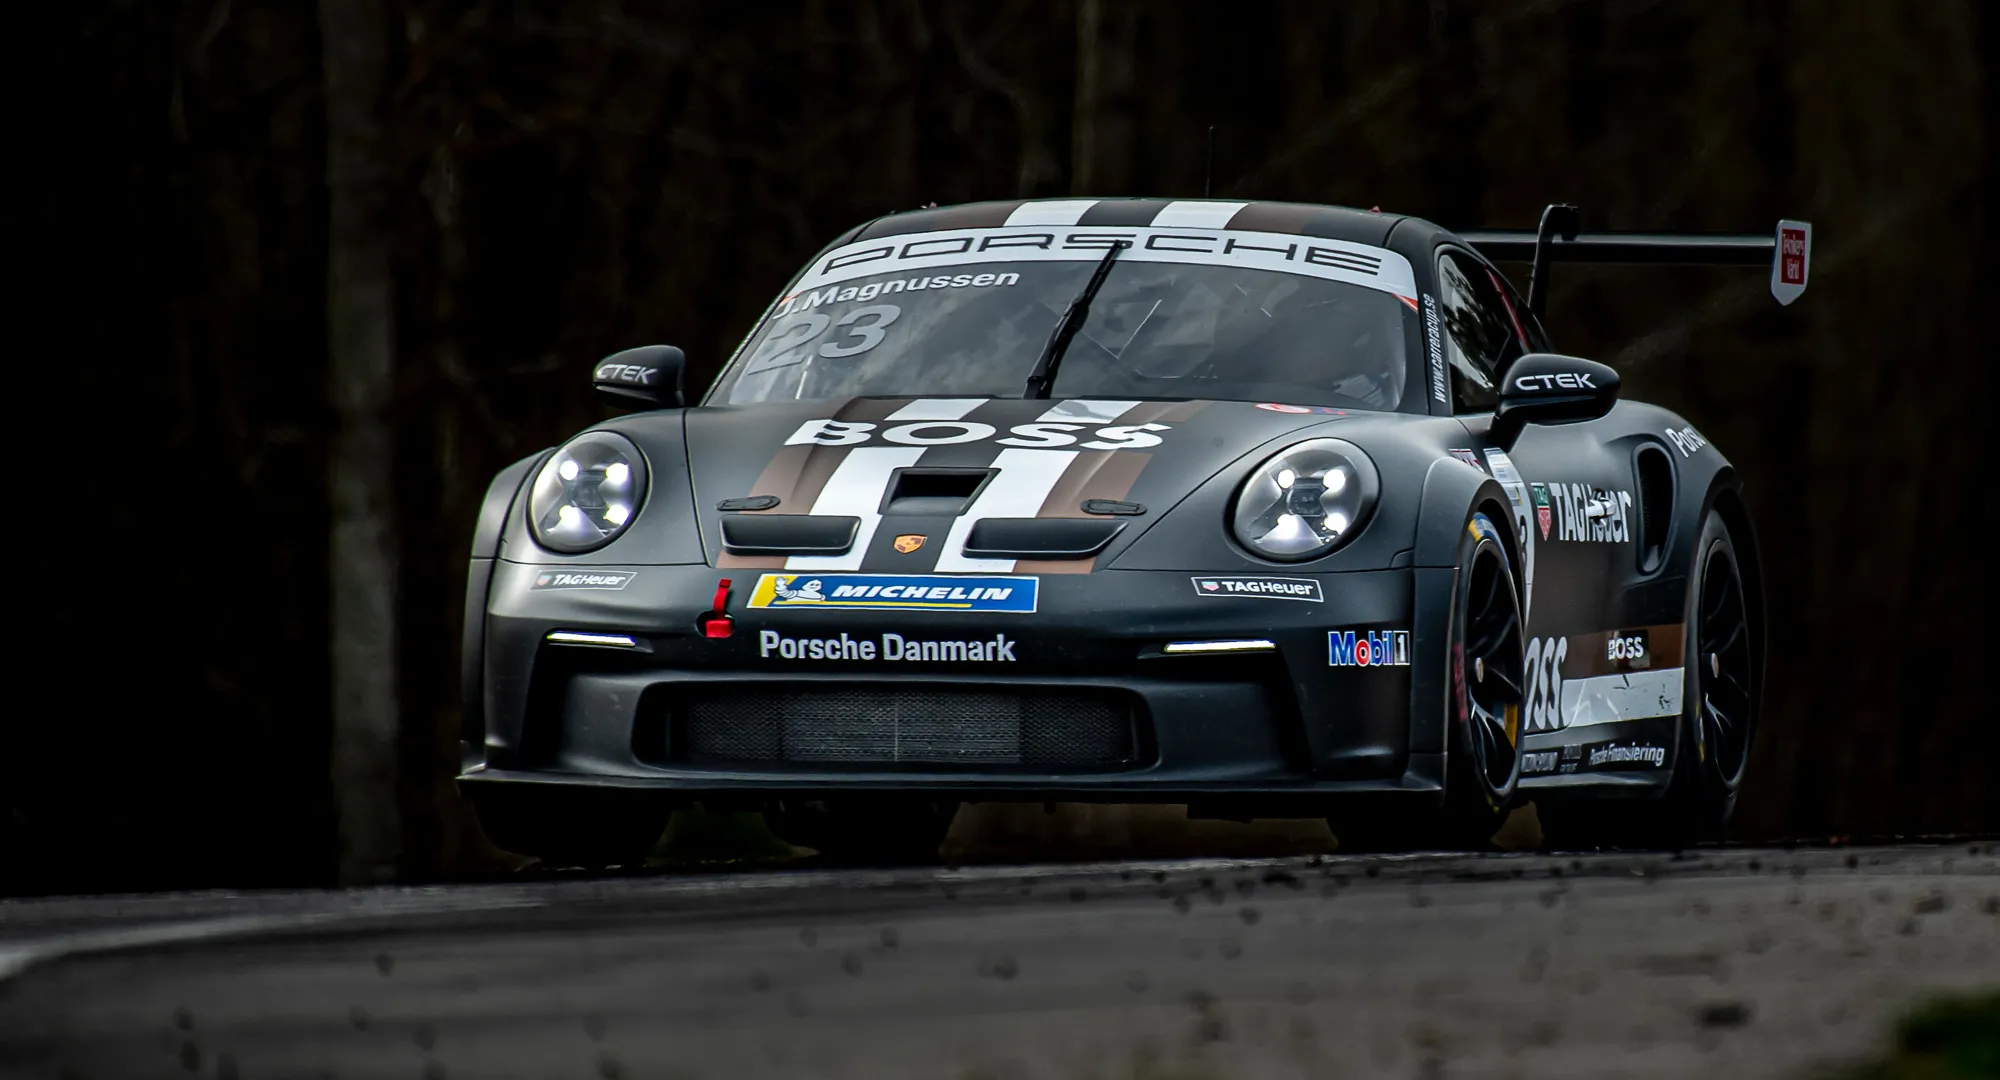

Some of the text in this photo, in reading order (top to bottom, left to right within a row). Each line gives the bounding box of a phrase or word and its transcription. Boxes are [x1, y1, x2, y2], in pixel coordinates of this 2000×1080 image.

[821, 233, 1382, 276] PORSCHE
[772, 271, 1020, 320] J.Magnussen
[747, 304, 901, 376] 23
[1422, 293, 1447, 403] www.carreracup.se
[596, 363, 658, 384] CTEK
[1515, 373, 1597, 391] CTEK
[784, 419, 1173, 450] BOSS
[831, 585, 1013, 601] MICHELIN
[760, 630, 1017, 662] Porsche Danmark
[1328, 630, 1393, 666] Mobil
[1608, 636, 1644, 661] BOSS
[1523, 636, 1568, 731] OSS
